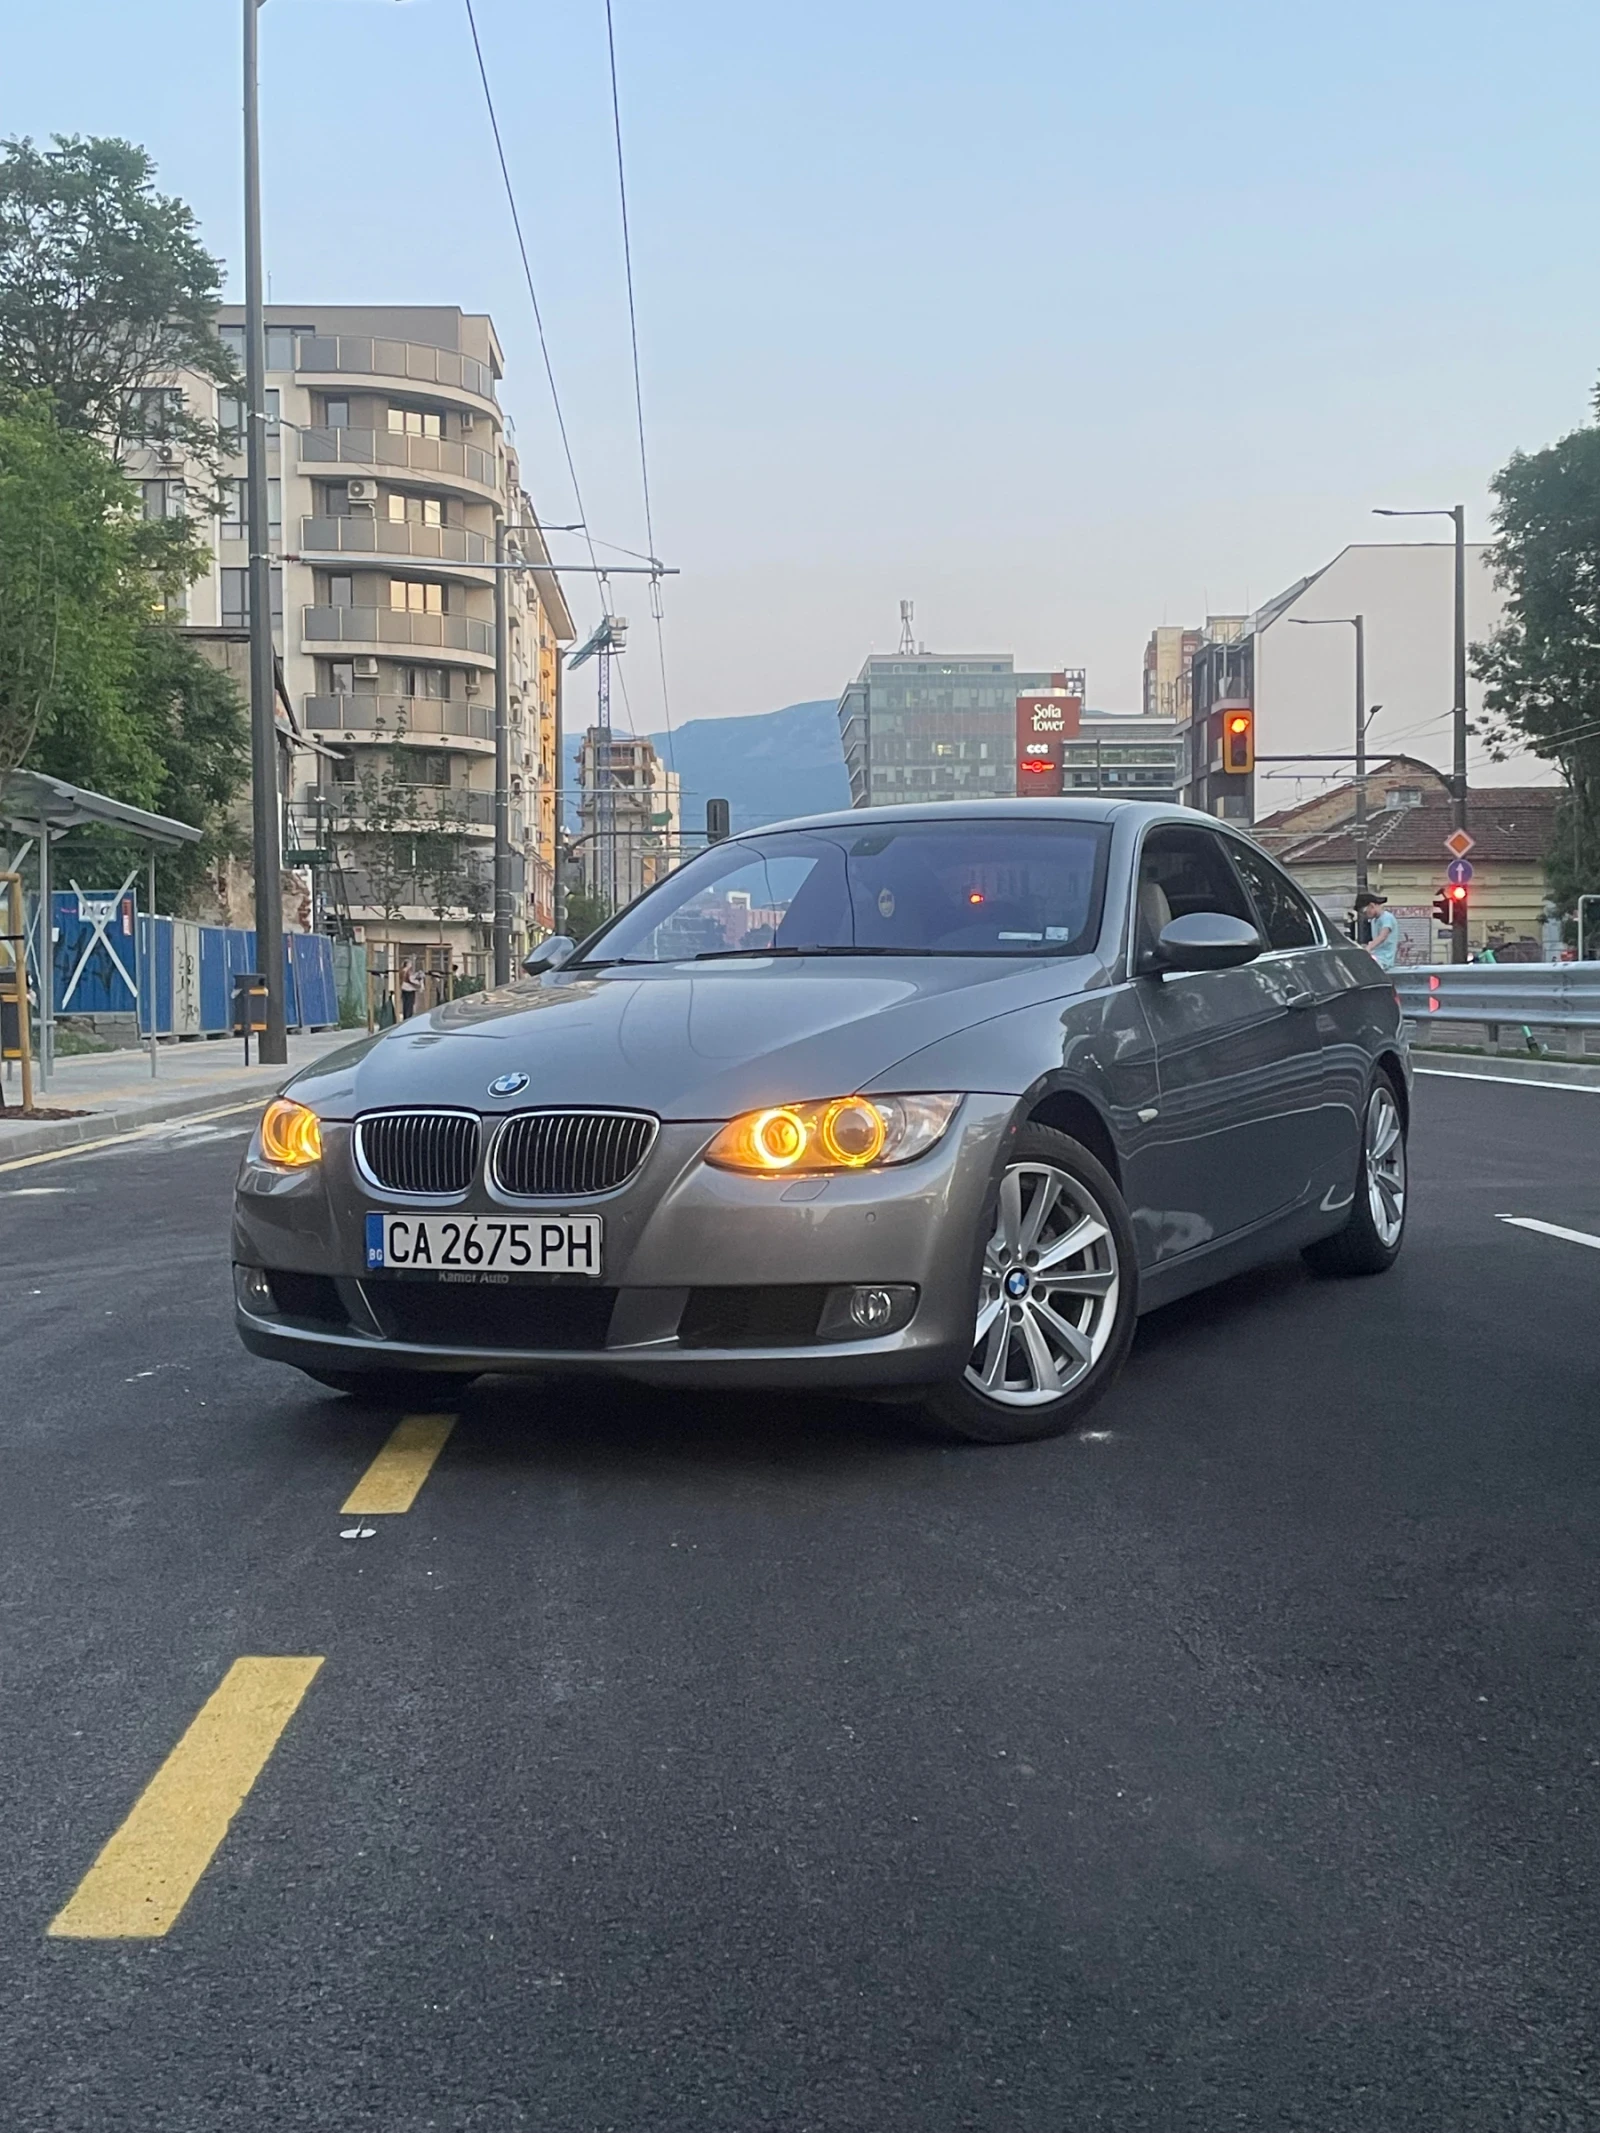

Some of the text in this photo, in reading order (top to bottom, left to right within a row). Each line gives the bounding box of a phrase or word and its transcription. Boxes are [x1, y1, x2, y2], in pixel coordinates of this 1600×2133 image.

[1034, 704, 1061, 718] Sofia
[1030, 714, 1065, 731] Tower
[389, 1221, 592, 1268] CA 2675 PH
[368, 1248, 383, 1261] BG
[479, 1272, 510, 1284] Auto
